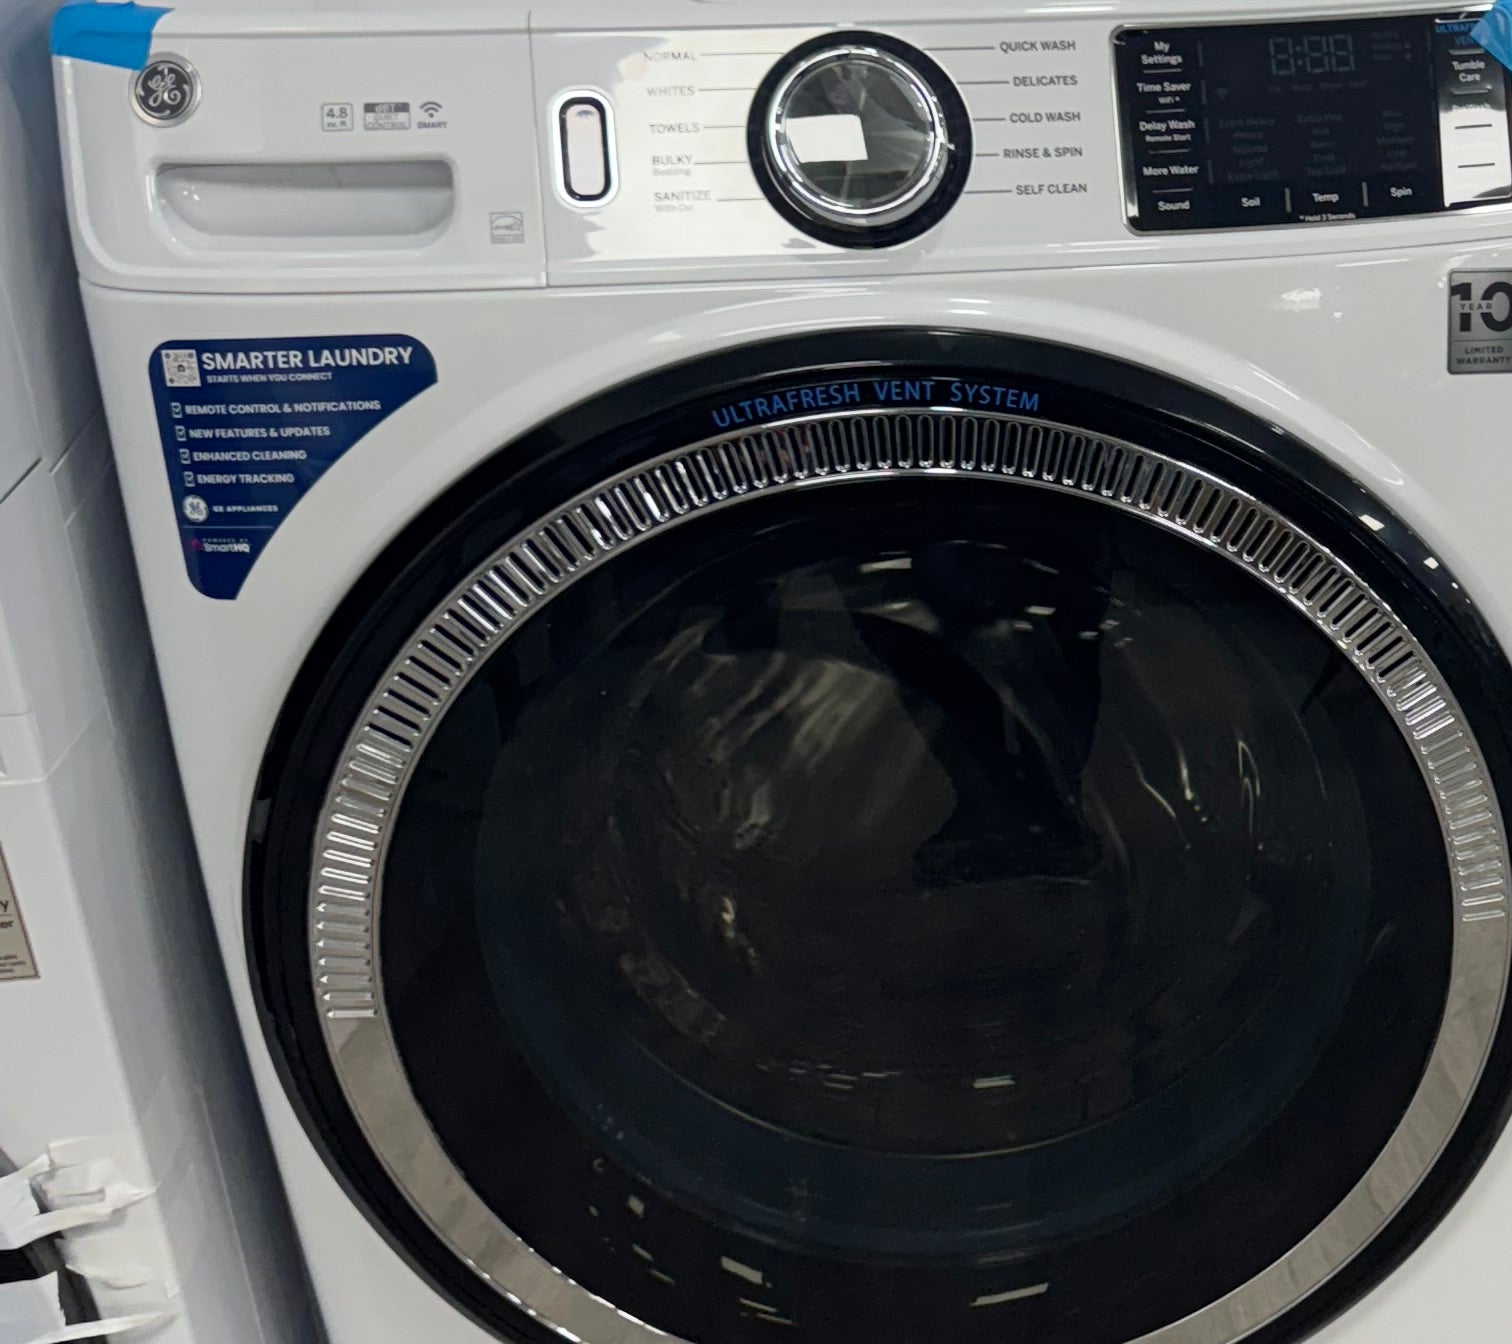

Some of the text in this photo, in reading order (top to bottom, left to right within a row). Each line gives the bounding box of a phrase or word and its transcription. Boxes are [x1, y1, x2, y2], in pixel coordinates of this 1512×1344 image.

[1000, 40, 1076, 54] QUICK WASH
[1153, 41, 1170, 53] My
[643, 51, 699, 62] NORMAL
[1141, 54, 1183, 65] Settings
[1452, 60, 1485, 71] Tumble
[1012, 75, 1078, 87] DELICATES
[1459, 73, 1480, 82] Care
[646, 85, 696, 97] WHITES
[1136, 81, 1192, 93] Time Saver
[326, 107, 348, 119] 4.8
[1009, 112, 1081, 123] COLD WASH
[648, 123, 701, 135] TOWELS
[1139, 120, 1196, 132] Delay Wash
[1003, 146, 1083, 158] RINSE & SPIN
[652, 154, 693, 166] BULKY
[1142, 165, 1200, 176] More Water
[1016, 183, 1088, 195] SELF CLEAN
[1390, 186, 1413, 198] Spin
[653, 189, 712, 202] SANITIZE
[1312, 192, 1340, 203] Temp
[1157, 199, 1191, 211] Sound
[1241, 197, 1261, 208] Soil
[1460, 302, 1492, 311] YEAR
[1464, 346, 1504, 355] LIMITED
[202, 346, 413, 370] SMARTER LAUNDRY
[1456, 357, 1512, 365] WARRANTY
[206, 372, 332, 383] STARTS WHEN YOU CONNECT
[185, 405, 228, 415] REMOTE
[229, 404, 282, 414] CONTROL
[294, 400, 382, 413] NOTIFICATIONS
[711, 381, 1040, 428] ULTRAFRESH VENT SYSTEM
[189, 428, 214, 439] NEW
[215, 428, 268, 438] FEATURES
[281, 426, 331, 437] UPDATES
[192, 450, 308, 462] ENHANCED CLEANING
[197, 473, 295, 484] ENERGY TRACKING
[203, 543, 250, 553] SmartHQ
